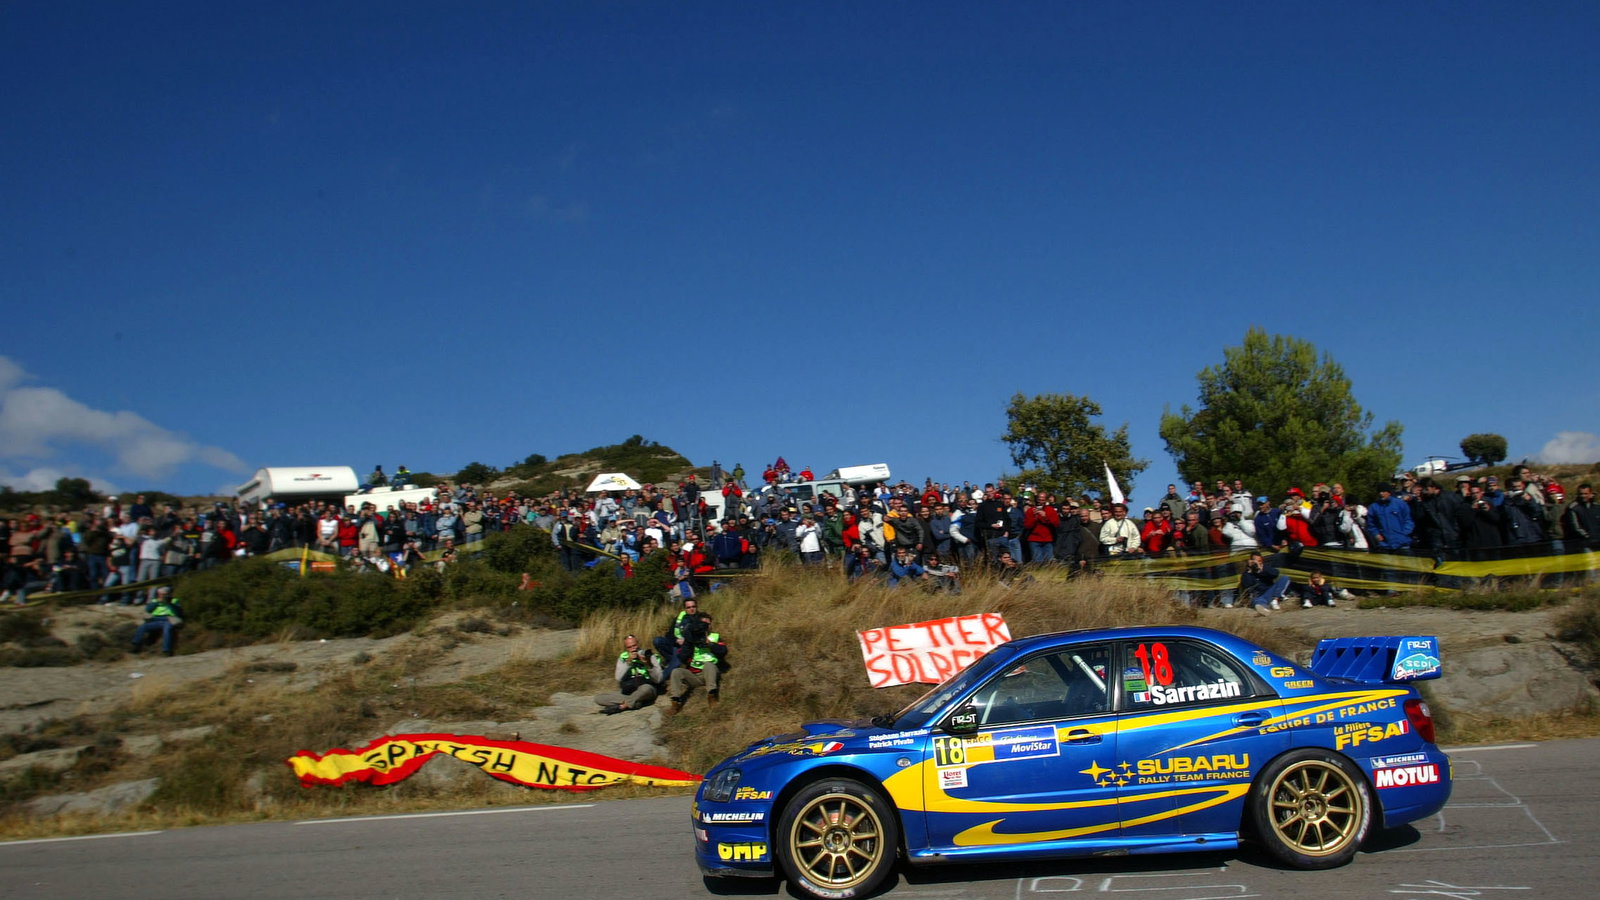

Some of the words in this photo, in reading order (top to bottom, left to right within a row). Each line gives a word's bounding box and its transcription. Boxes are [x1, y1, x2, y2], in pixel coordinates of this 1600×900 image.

[860, 612, 1011, 655] PETTER
[1407, 640, 1431, 650] FIRST
[1135, 642, 1174, 686] 18
[1151, 678, 1241, 705] Sarrazin
[952, 713, 977, 726] FIRST
[1259, 717, 1310, 735] EQUIPE
[1316, 711, 1334, 724] DE
[1340, 698, 1396, 718] FRANCE
[1333, 726, 1344, 736] La
[1336, 721, 1402, 751] FFSA
[936, 737, 964, 765] 18
[1011, 741, 1052, 753] MoviStar
[1137, 753, 1249, 775] SUBARU
[1386, 754, 1425, 764] MICHELIN
[1139, 775, 1170, 784] RALLY
[1175, 773, 1203, 782] TEAM
[1206, 770, 1250, 780] FRANCE
[1376, 765, 1438, 787] MOTUL
[735, 791, 767, 800] FFSA
[712, 812, 764, 820] MICHELIN
[718, 842, 767, 860] OMP
